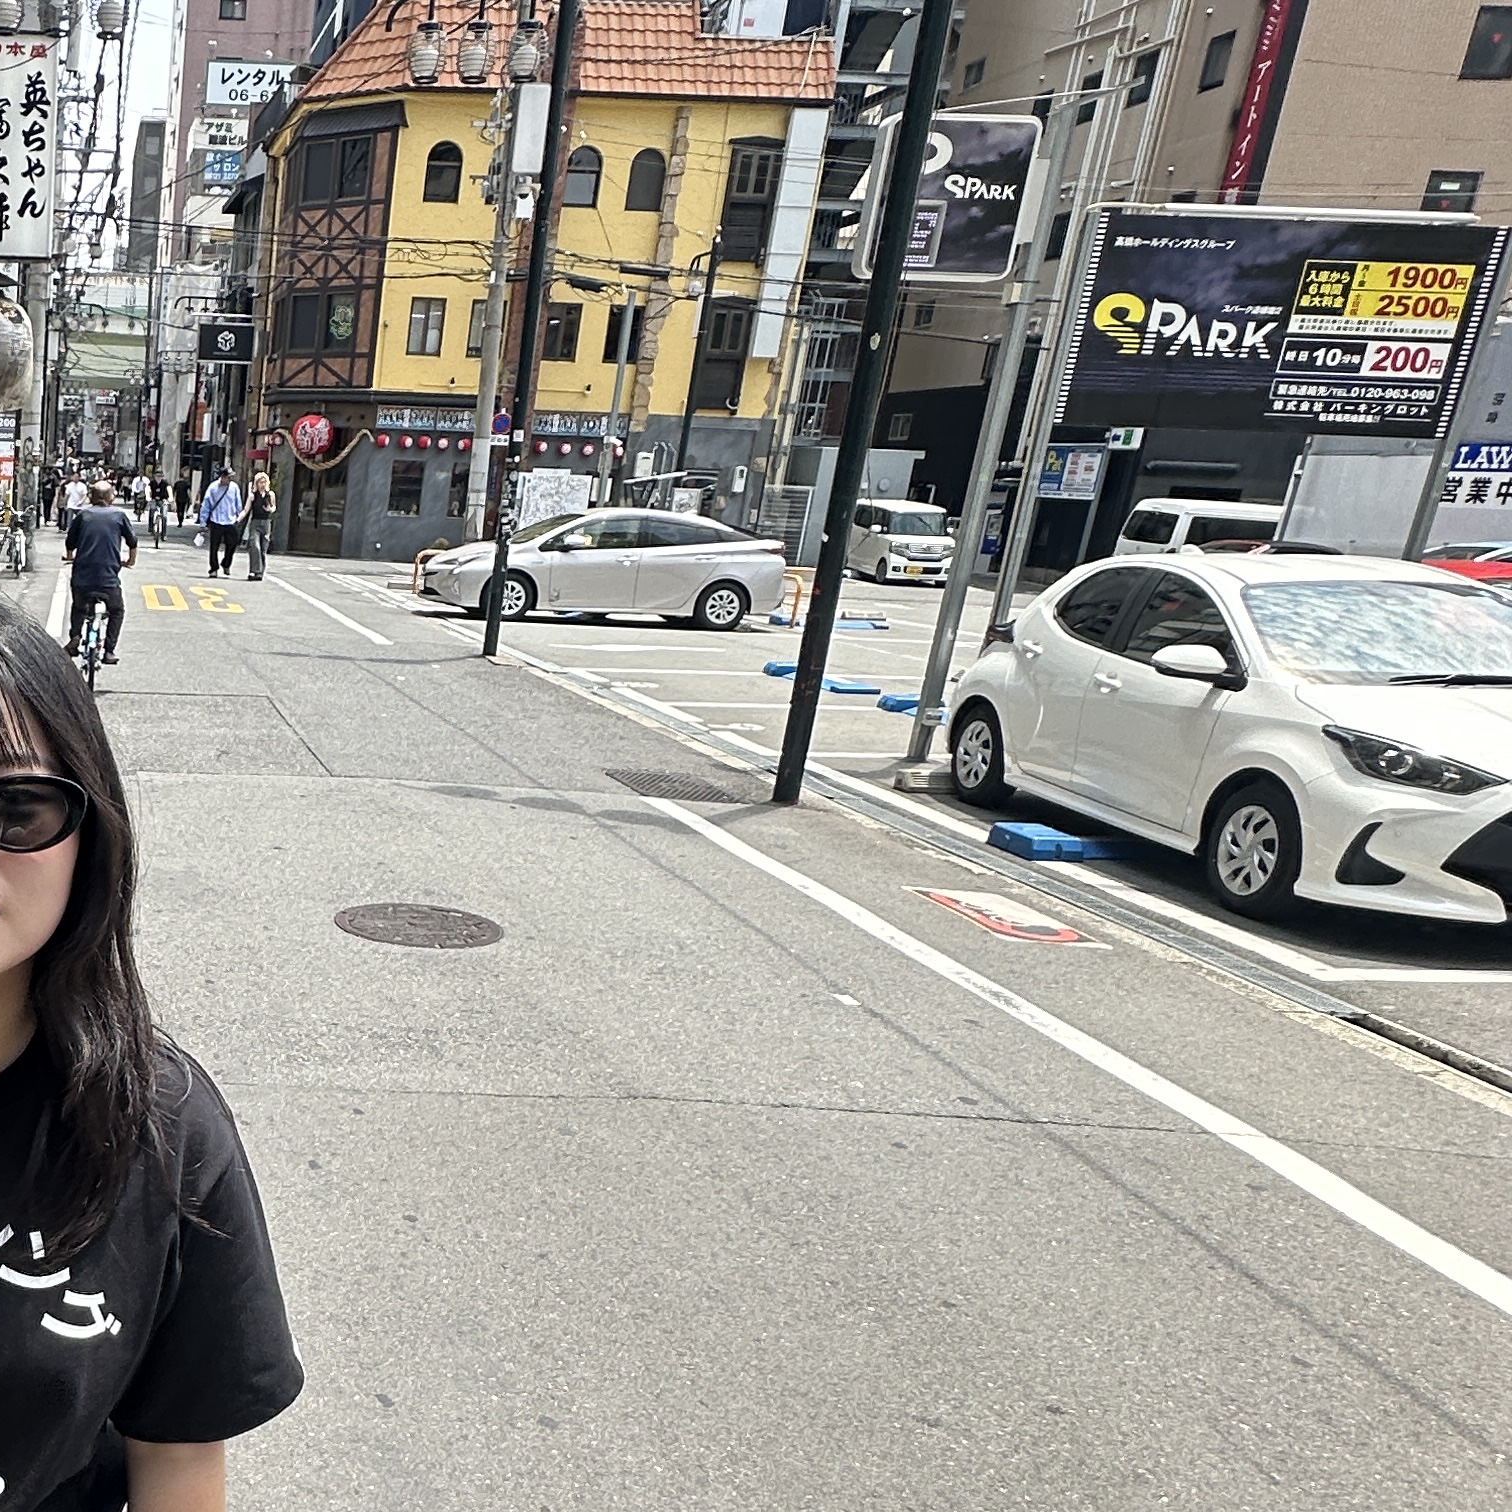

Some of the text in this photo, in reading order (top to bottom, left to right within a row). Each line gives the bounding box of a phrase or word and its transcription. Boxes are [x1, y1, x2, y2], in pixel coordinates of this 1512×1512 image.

[220, 67, 285, 87] レンタル
[944, 174, 1017, 200] SPARK
[1387, 265, 1469, 291] 1900円
[1374, 294, 1459, 320] 2500円
[1093, 292, 1280, 359] SPARK
[1369, 345, 1444, 375] 200円
